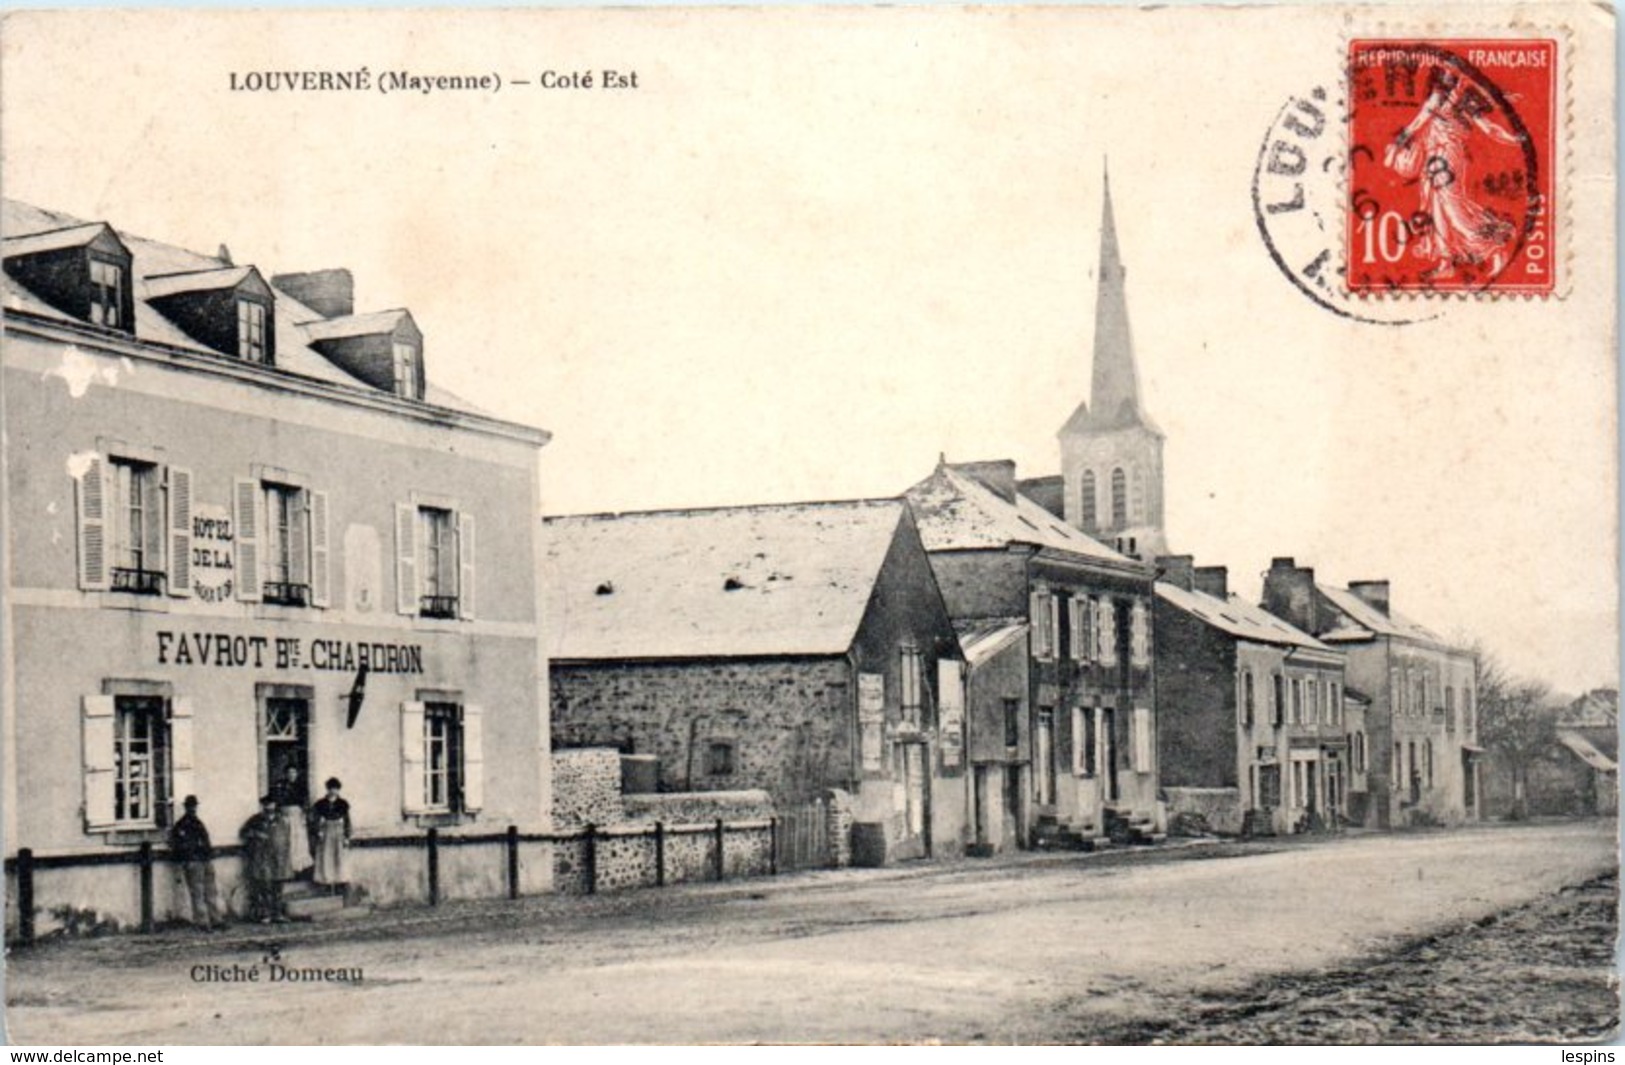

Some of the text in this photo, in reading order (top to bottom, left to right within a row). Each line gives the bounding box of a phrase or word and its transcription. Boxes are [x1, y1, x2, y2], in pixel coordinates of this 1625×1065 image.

[1468, 49, 1548, 69] FRANÇAISE
[1357, 210, 1406, 263] 10
[213, 549, 233, 569] LA
[156, 630, 268, 668] FAVROT
